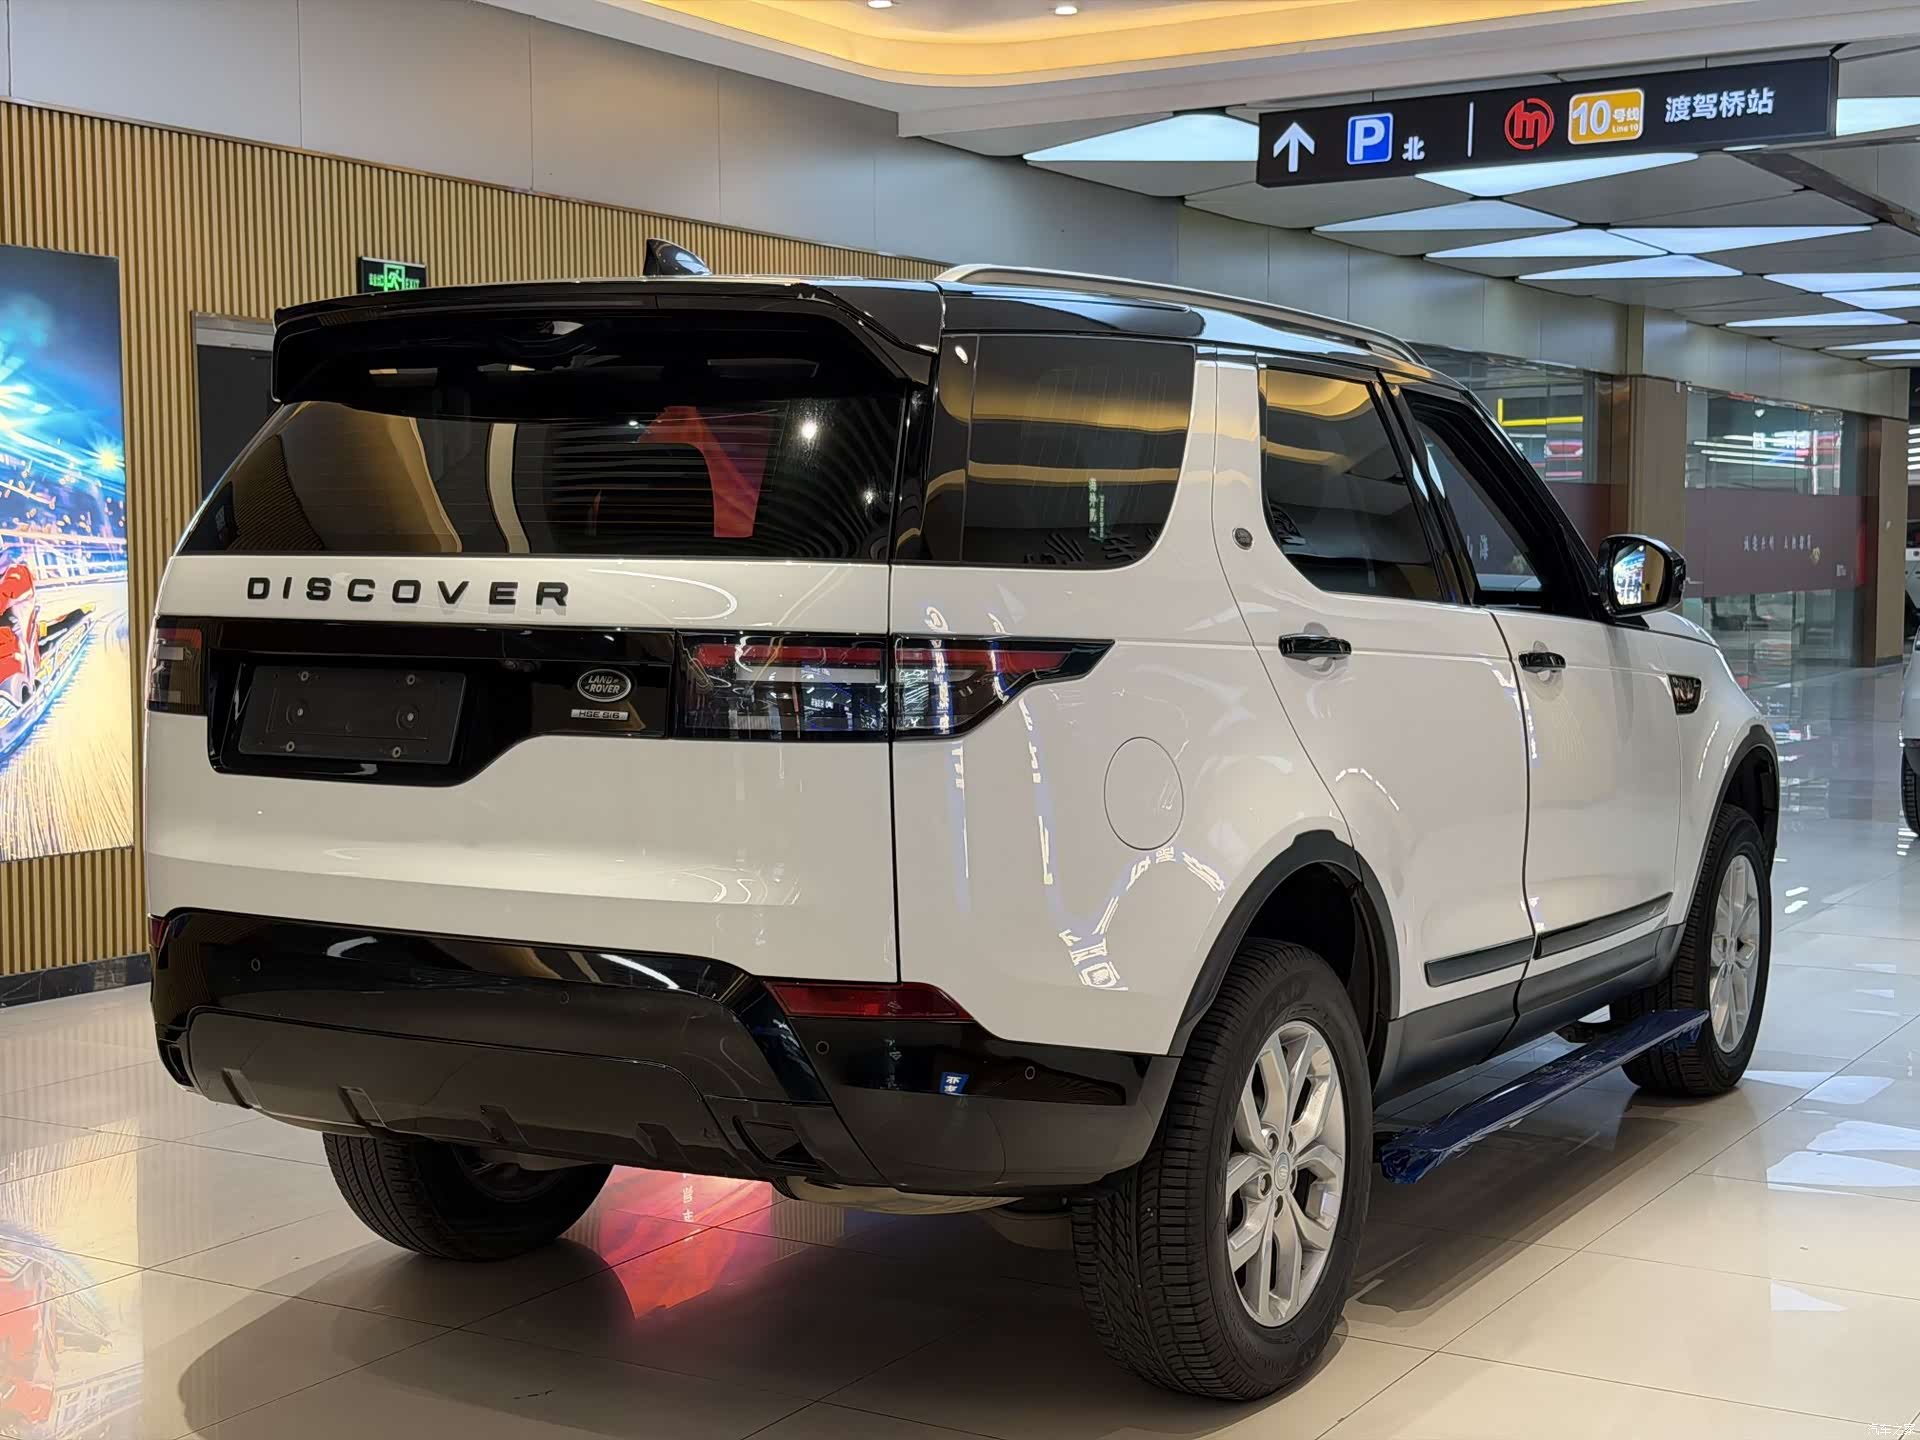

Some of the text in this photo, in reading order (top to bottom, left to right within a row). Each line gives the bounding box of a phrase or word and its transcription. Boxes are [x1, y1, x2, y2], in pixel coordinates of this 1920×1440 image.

[1664, 87, 1776, 122] 渡驾桥站
[1572, 100, 1640, 136] 10 号线
[1612, 123, 1639, 133] Line 10
[1353, 118, 1425, 161] P 北
[246, 576, 570, 607] DISCOVER
[588, 675, 613, 684] LAND
[588, 684, 621, 694] ROVER
[579, 710, 600, 718] HSE
